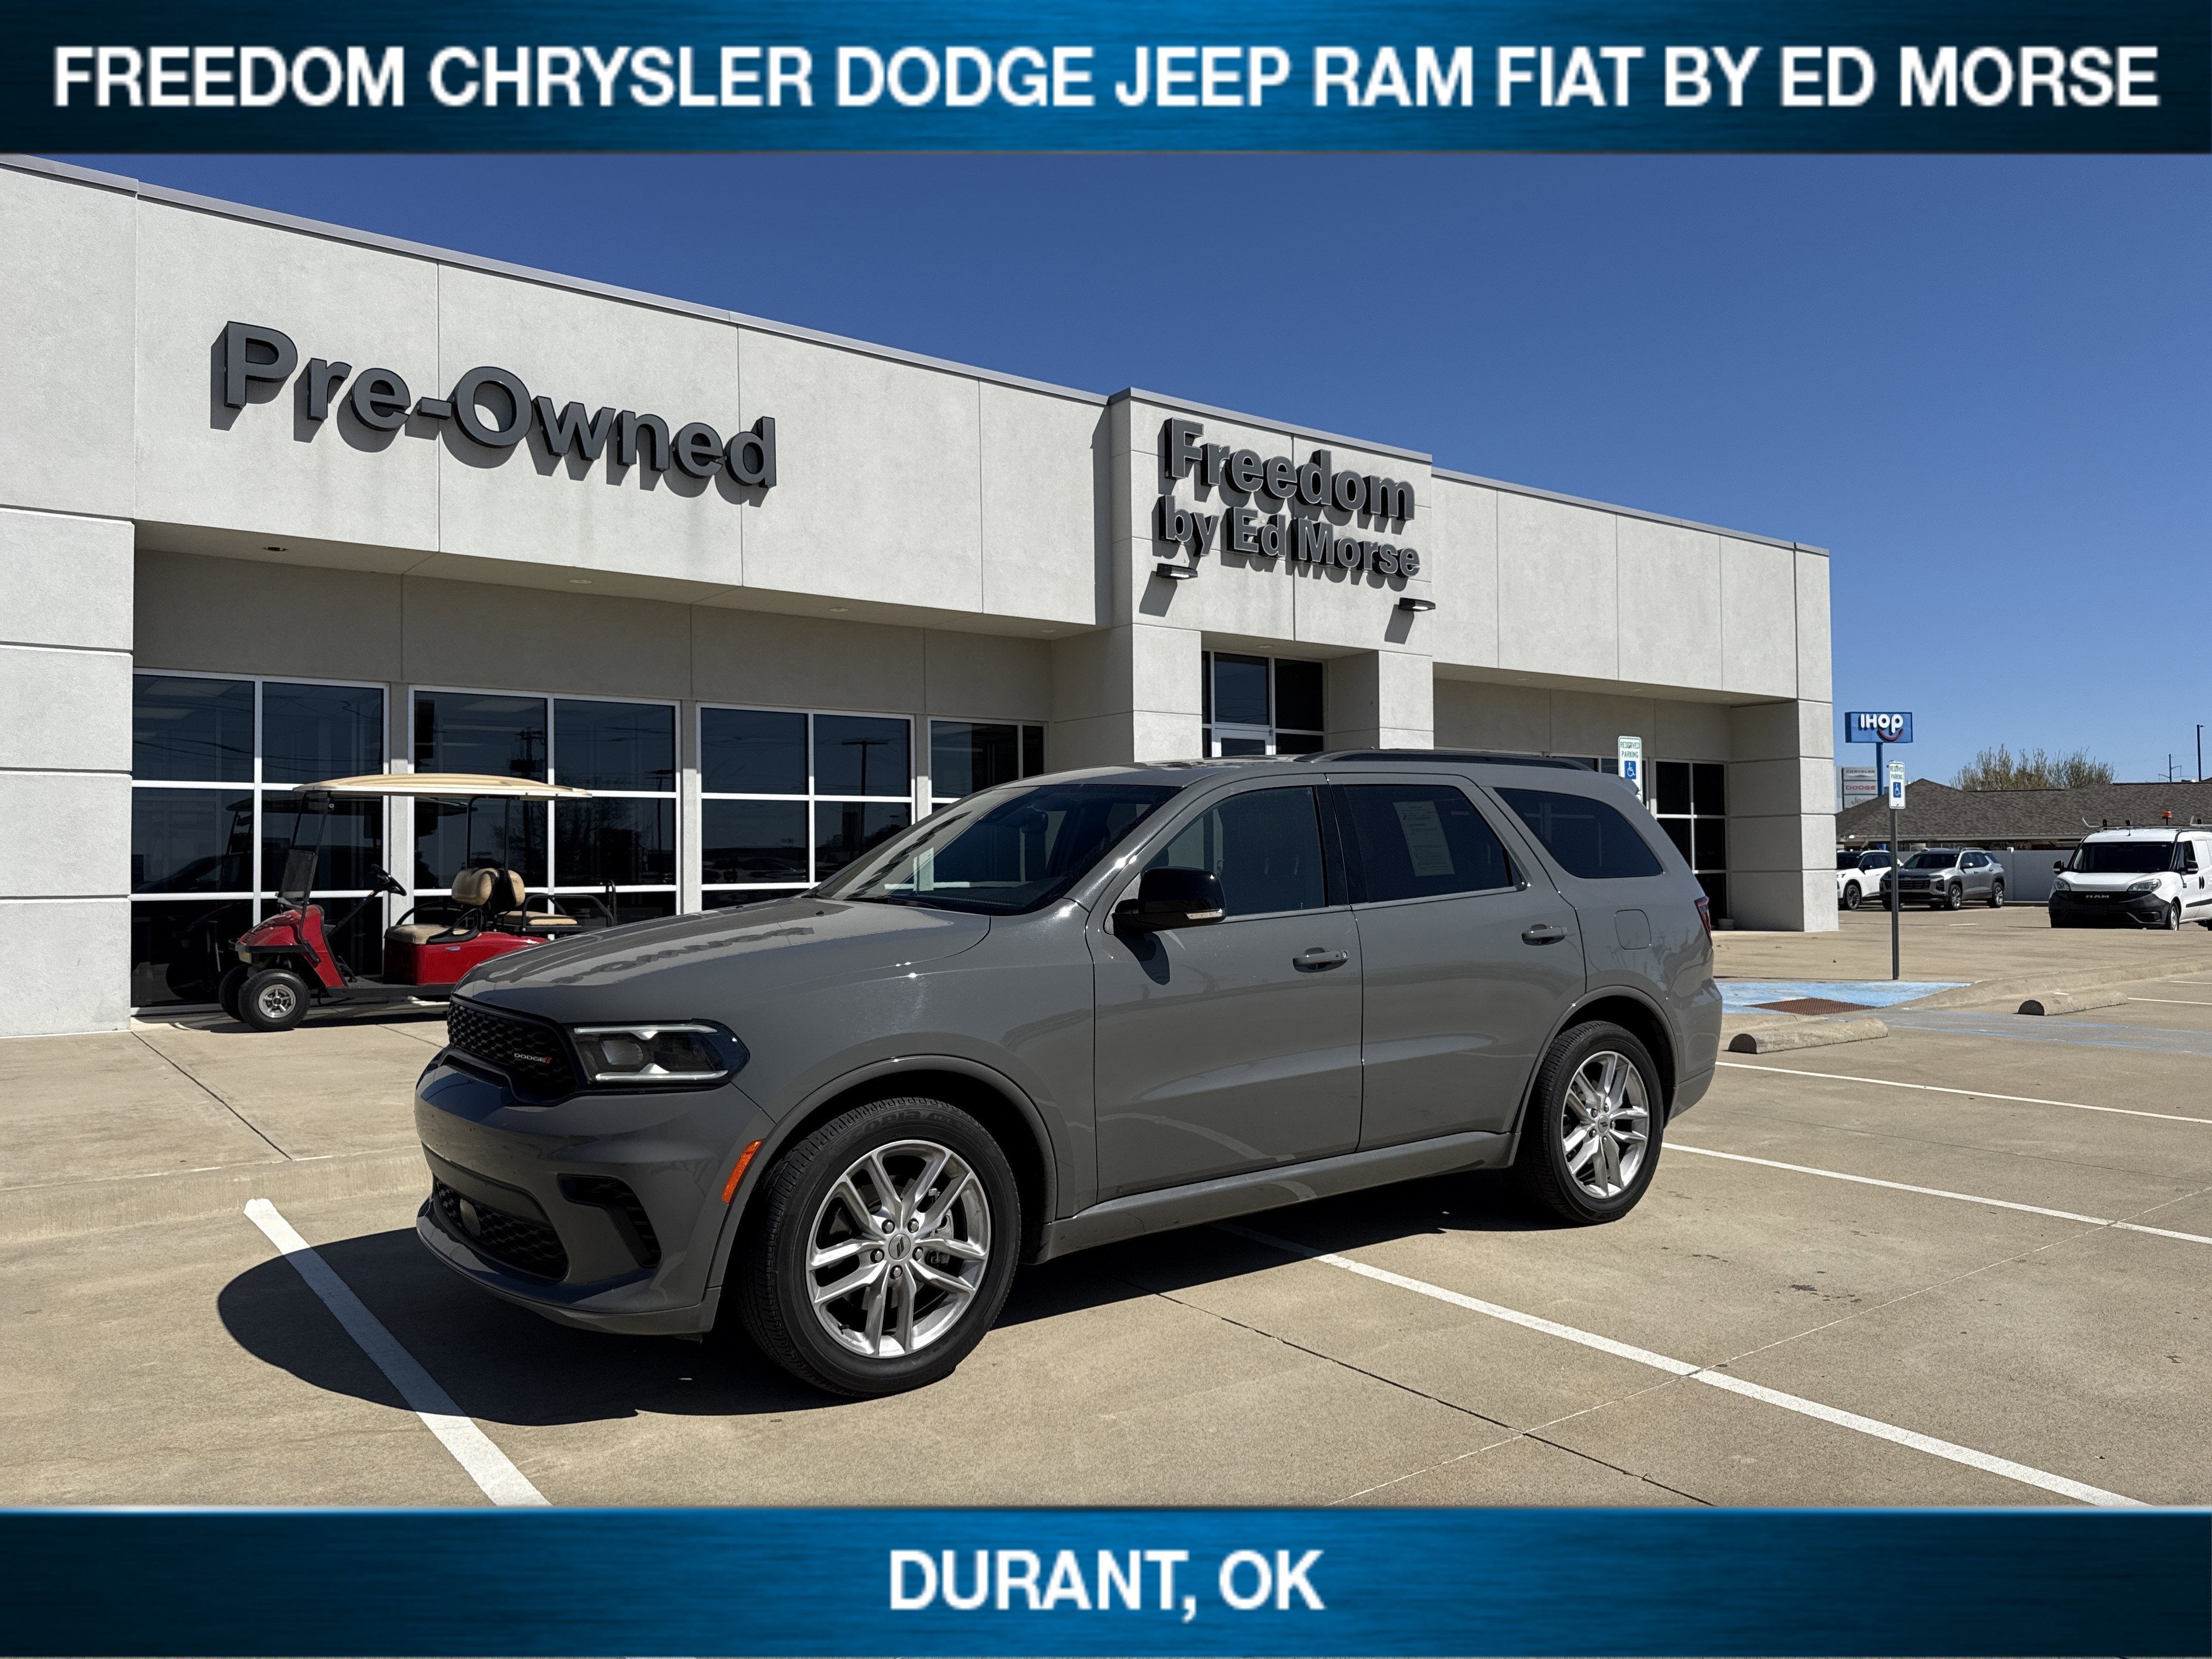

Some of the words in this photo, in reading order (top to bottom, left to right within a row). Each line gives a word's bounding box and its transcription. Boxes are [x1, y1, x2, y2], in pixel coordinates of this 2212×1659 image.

[222, 320, 777, 489] Pre-Owned
[1164, 417, 1414, 521] Freedom
[1159, 495, 1219, 556] by
[1229, 506, 1286, 556] Ed
[1293, 517, 1420, 578] Morse
[514, 1053, 546, 1063] DODGE
